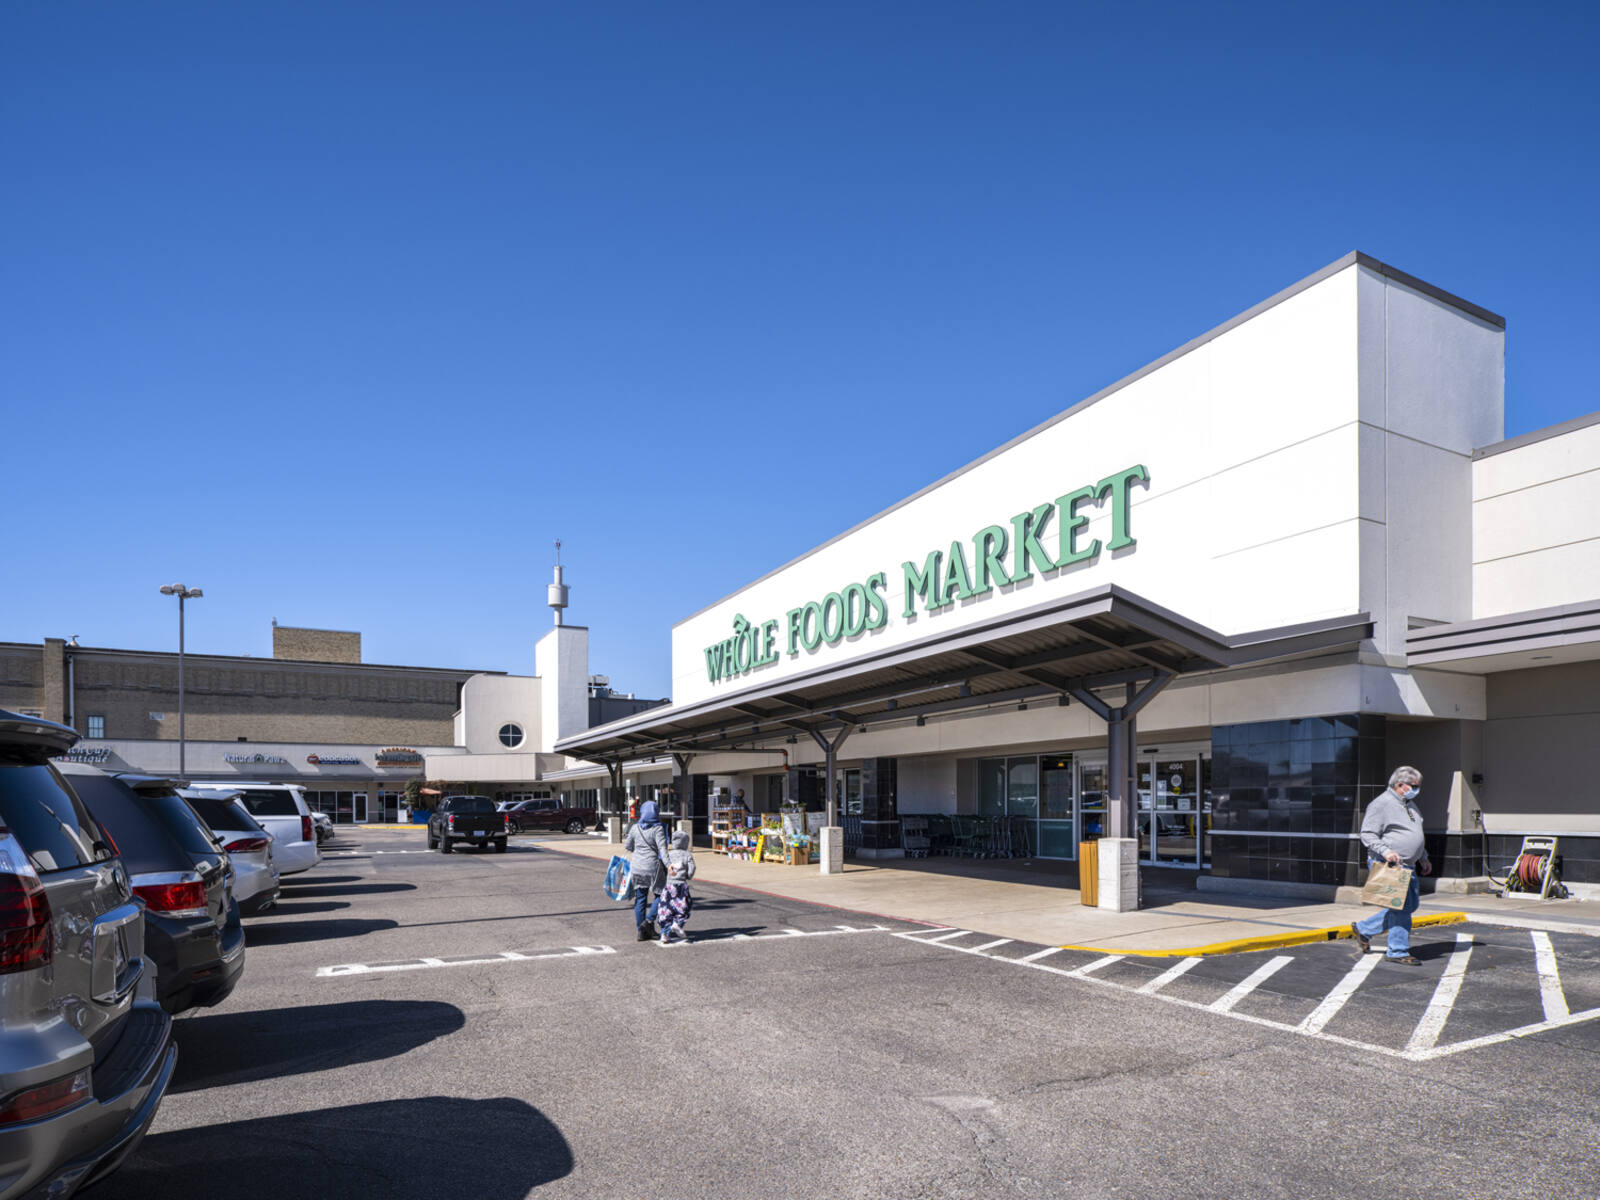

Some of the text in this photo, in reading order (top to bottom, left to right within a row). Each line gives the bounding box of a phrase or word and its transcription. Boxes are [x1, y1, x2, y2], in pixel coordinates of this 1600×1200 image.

[704, 464, 1150, 683] WHOLE FOODS MARKET
